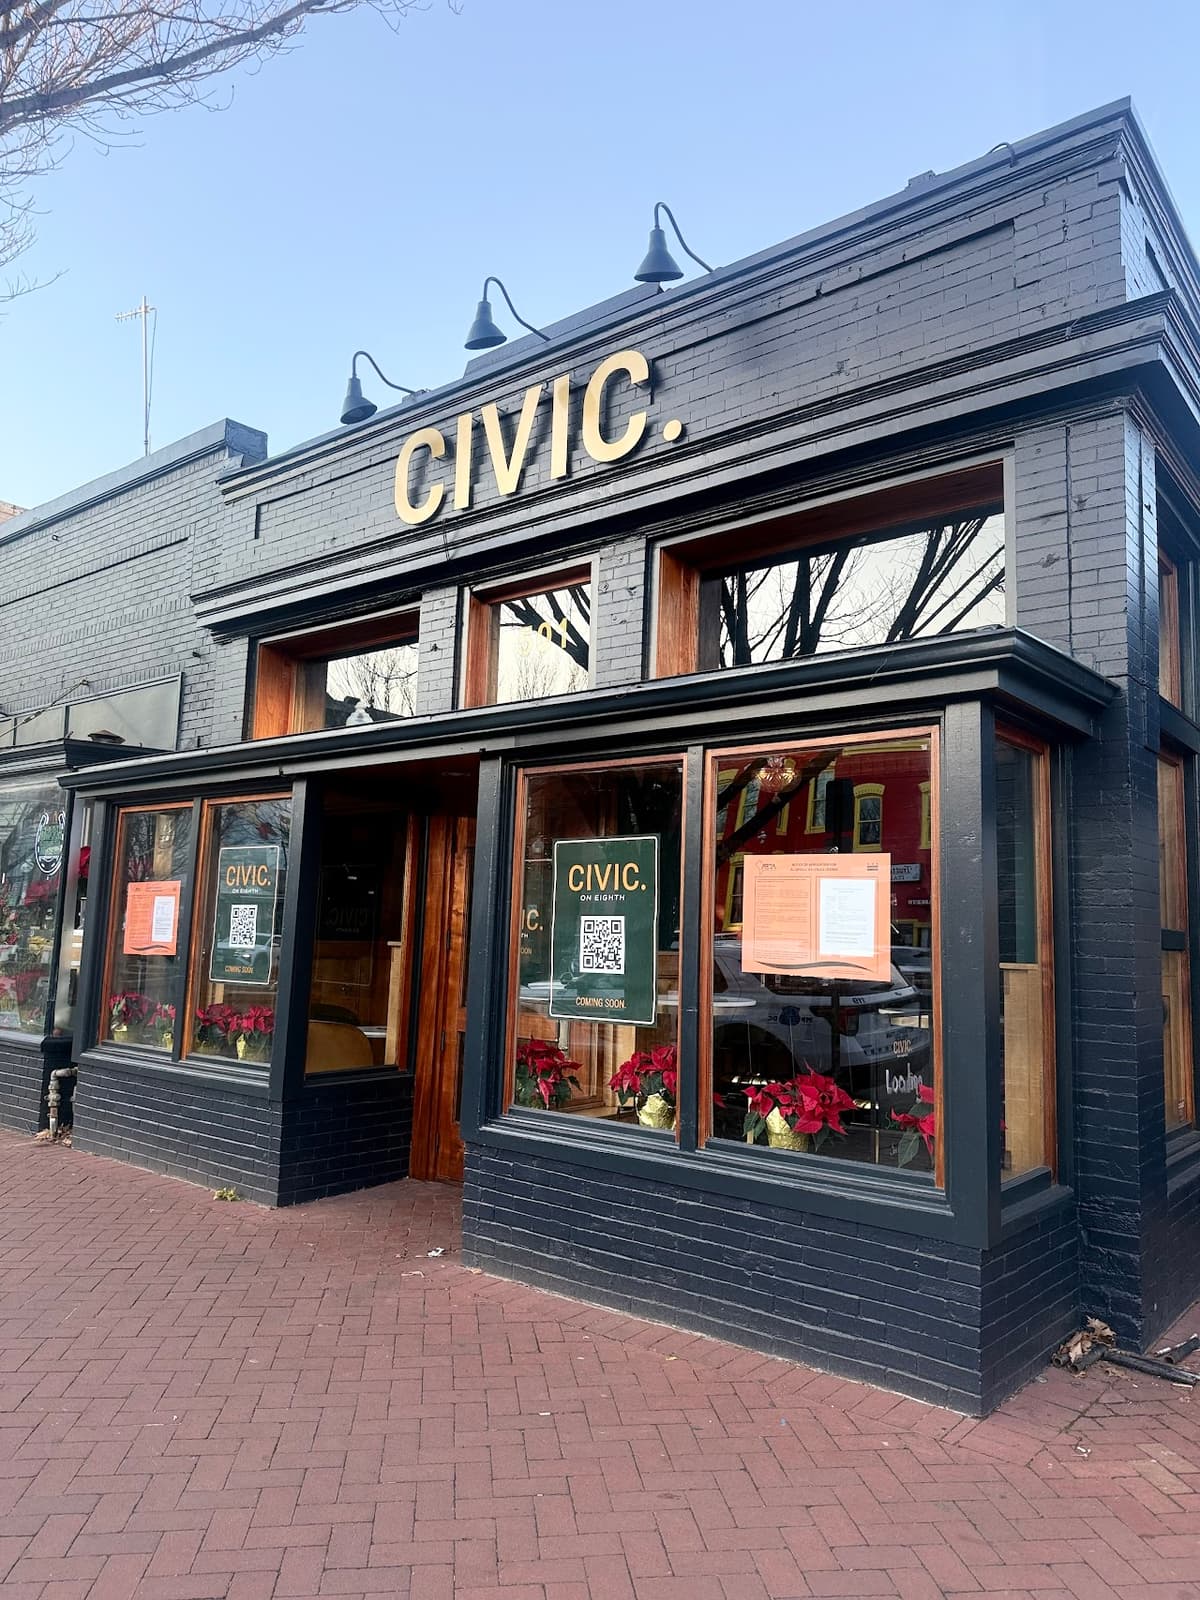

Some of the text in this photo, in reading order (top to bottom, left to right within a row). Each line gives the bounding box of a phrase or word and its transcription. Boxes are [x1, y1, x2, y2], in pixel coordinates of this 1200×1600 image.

[395, 350, 682, 525] CIVIC.
[226, 865, 271, 887] CIVIC.
[568, 863, 647, 892] CIVIC.
[575, 996, 627, 1009] COMING SOON.
